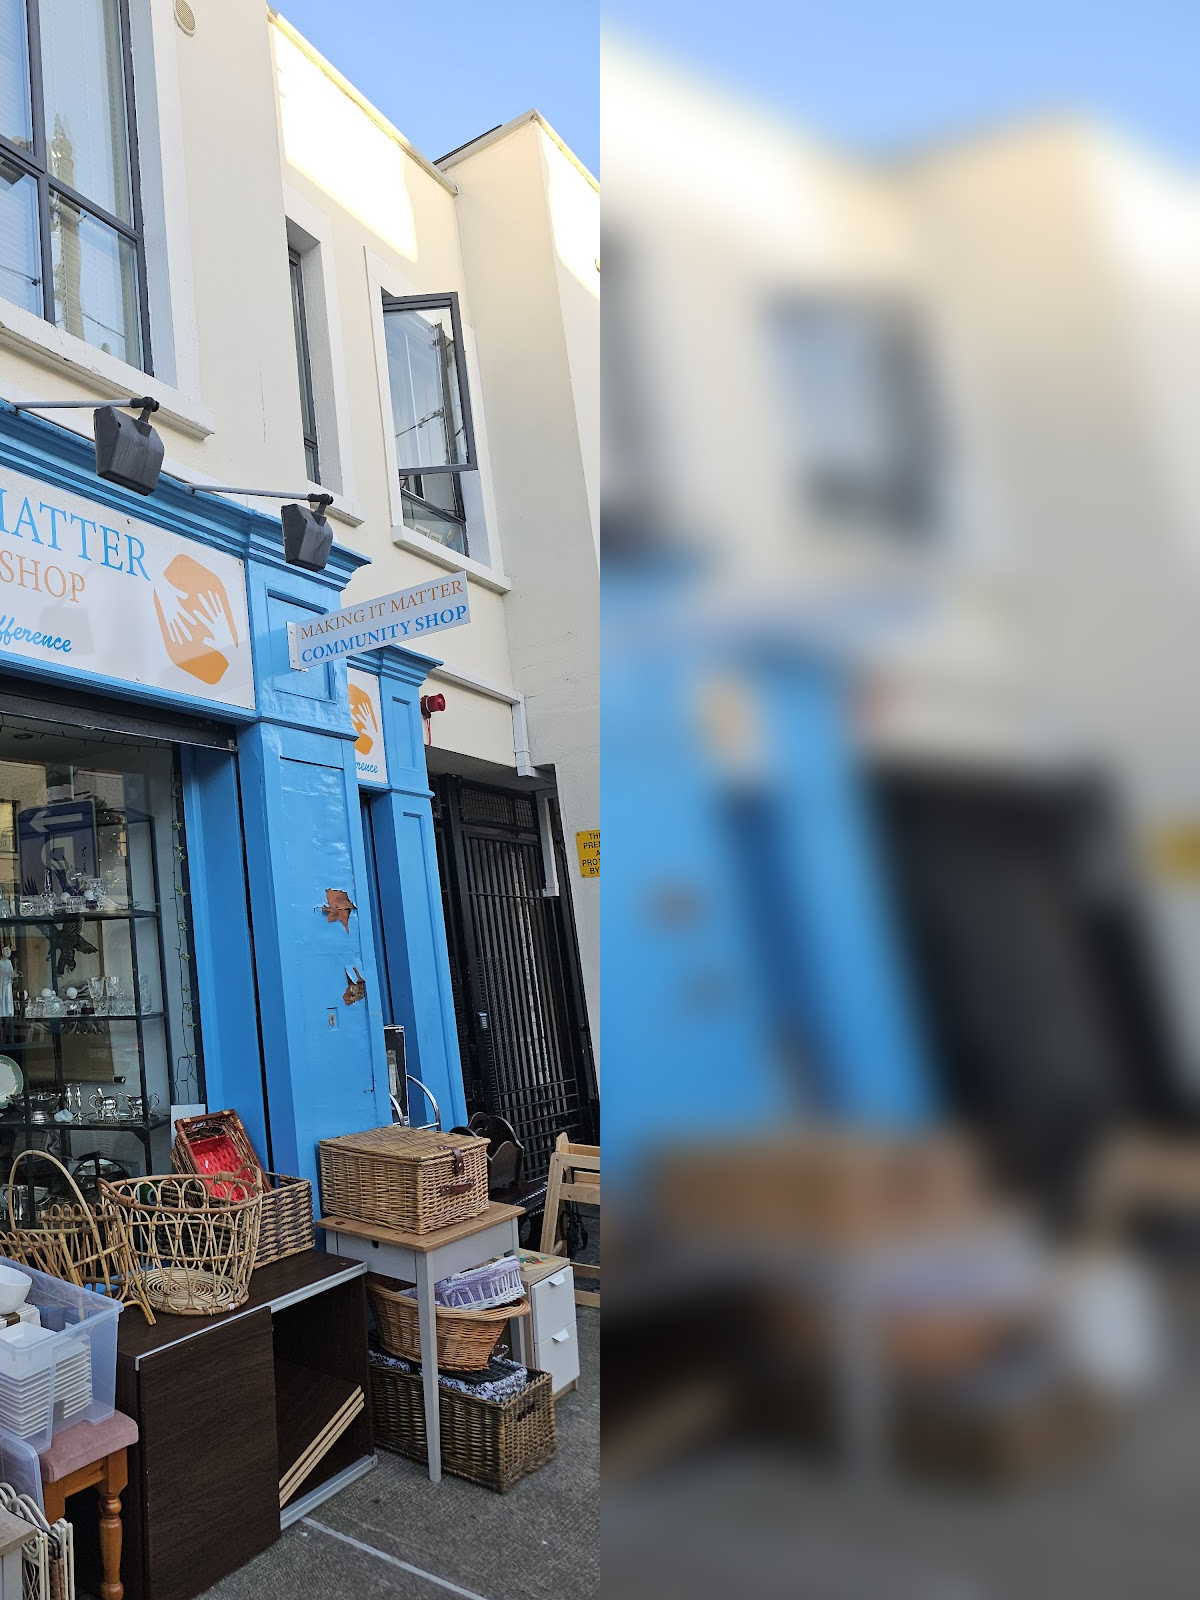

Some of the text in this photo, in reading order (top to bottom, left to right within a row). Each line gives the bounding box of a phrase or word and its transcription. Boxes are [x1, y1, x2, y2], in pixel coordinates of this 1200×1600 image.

[0, 550, 86, 603] SHOP
[301, 580, 464, 641] MAKING IT MATTER
[301, 605, 468, 664] COMMUNITY SHOP
